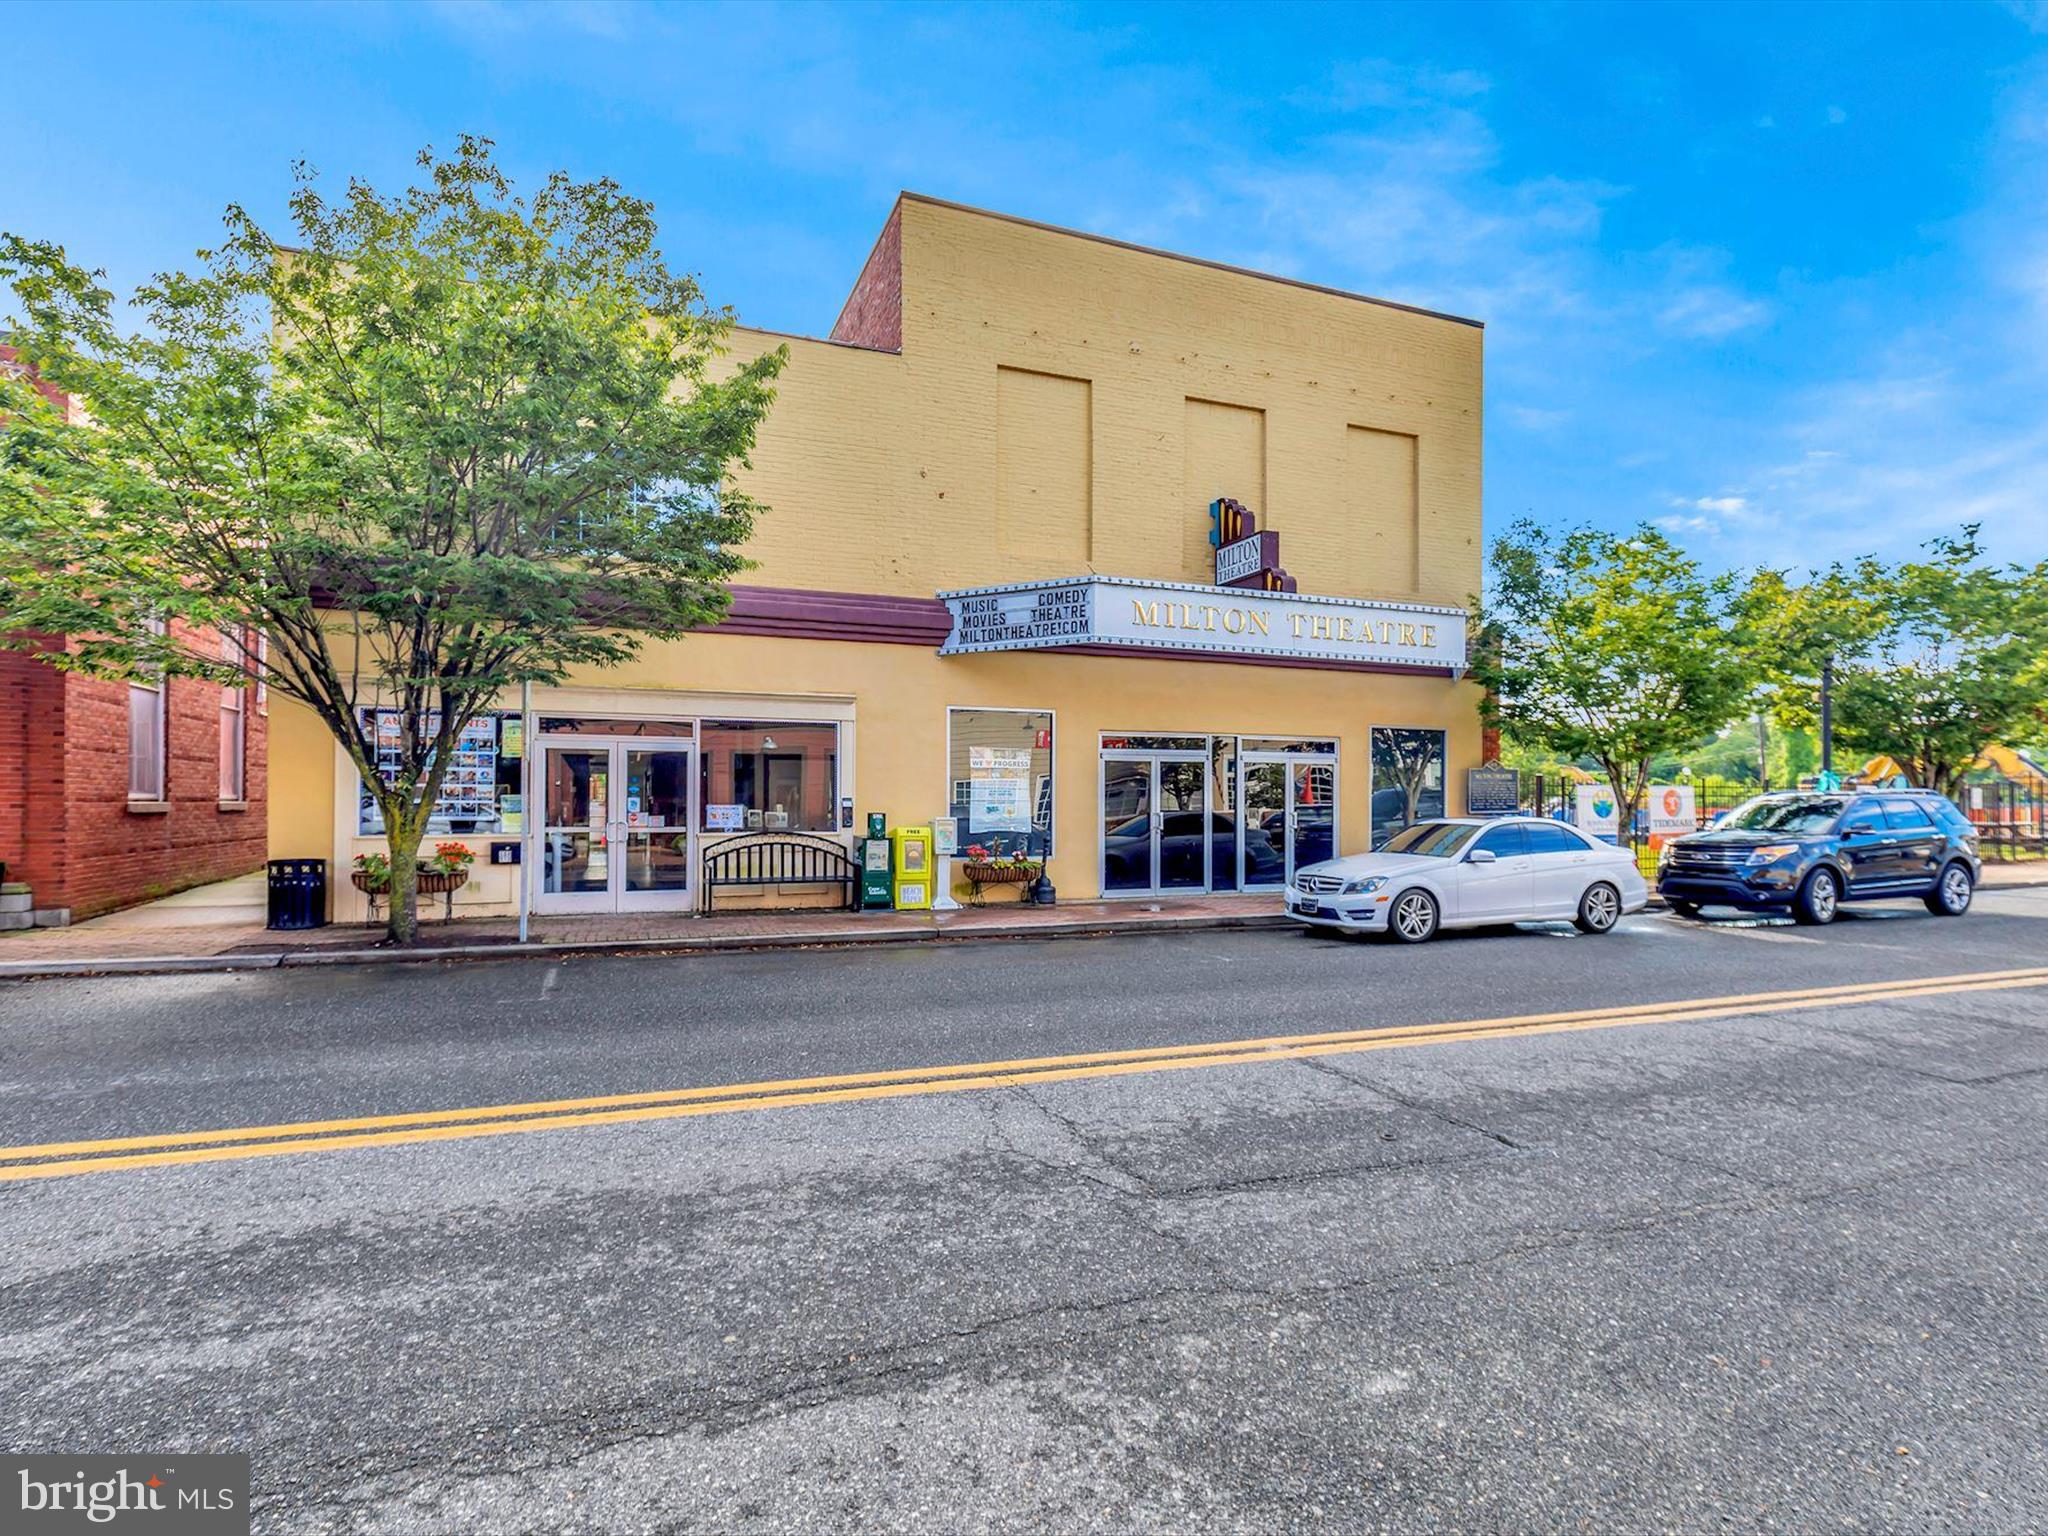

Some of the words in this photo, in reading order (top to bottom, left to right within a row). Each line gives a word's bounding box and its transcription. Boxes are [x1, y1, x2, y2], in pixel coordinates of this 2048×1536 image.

[1218, 538, 1260, 570] MILTON
[1219, 558, 1260, 582] THEATRE
[961, 599, 998, 615] MUSIC
[1038, 589, 1089, 607] COMEDY
[962, 612, 1006, 629] MOVIES
[1032, 604, 1087, 623] THEATRE
[1132, 599, 1270, 636] MILTON
[1286, 613, 1438, 648] THEATRE
[993, 760, 1029, 768] PROGRESS
